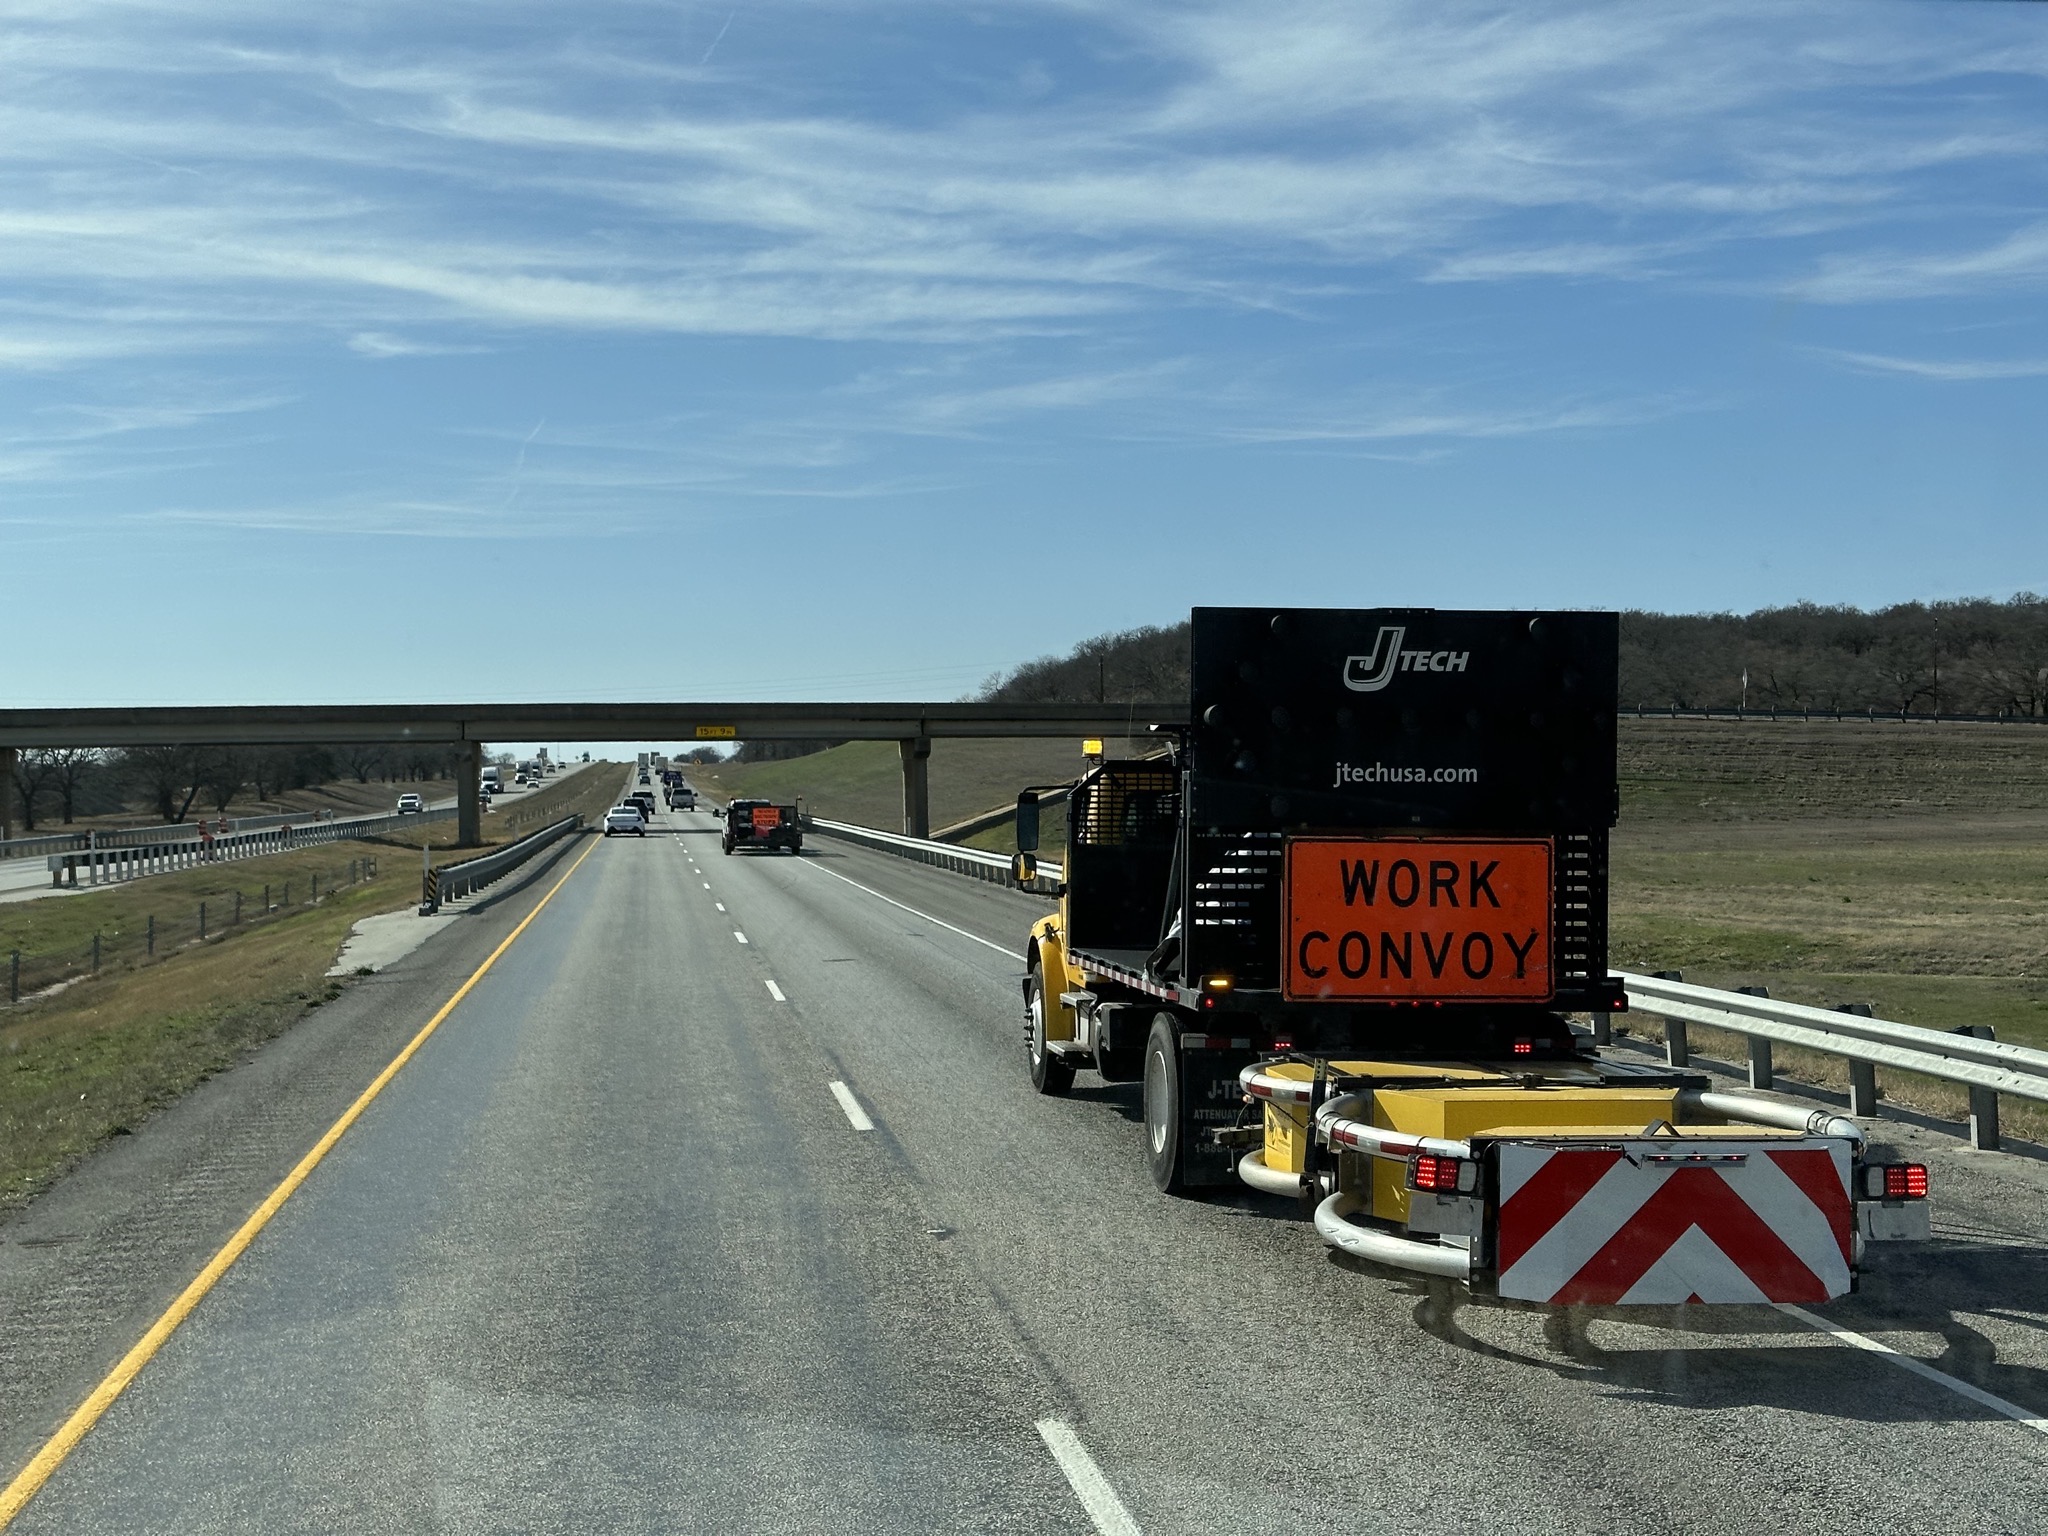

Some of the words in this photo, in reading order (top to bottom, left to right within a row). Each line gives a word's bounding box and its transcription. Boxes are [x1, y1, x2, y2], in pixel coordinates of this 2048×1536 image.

[1333, 762, 1478, 788] jtechusa.com
[1340, 859, 1501, 908] WORK
[1299, 930, 1540, 980] CONVOY
[1207, 1079, 1242, 1099] J-TE
